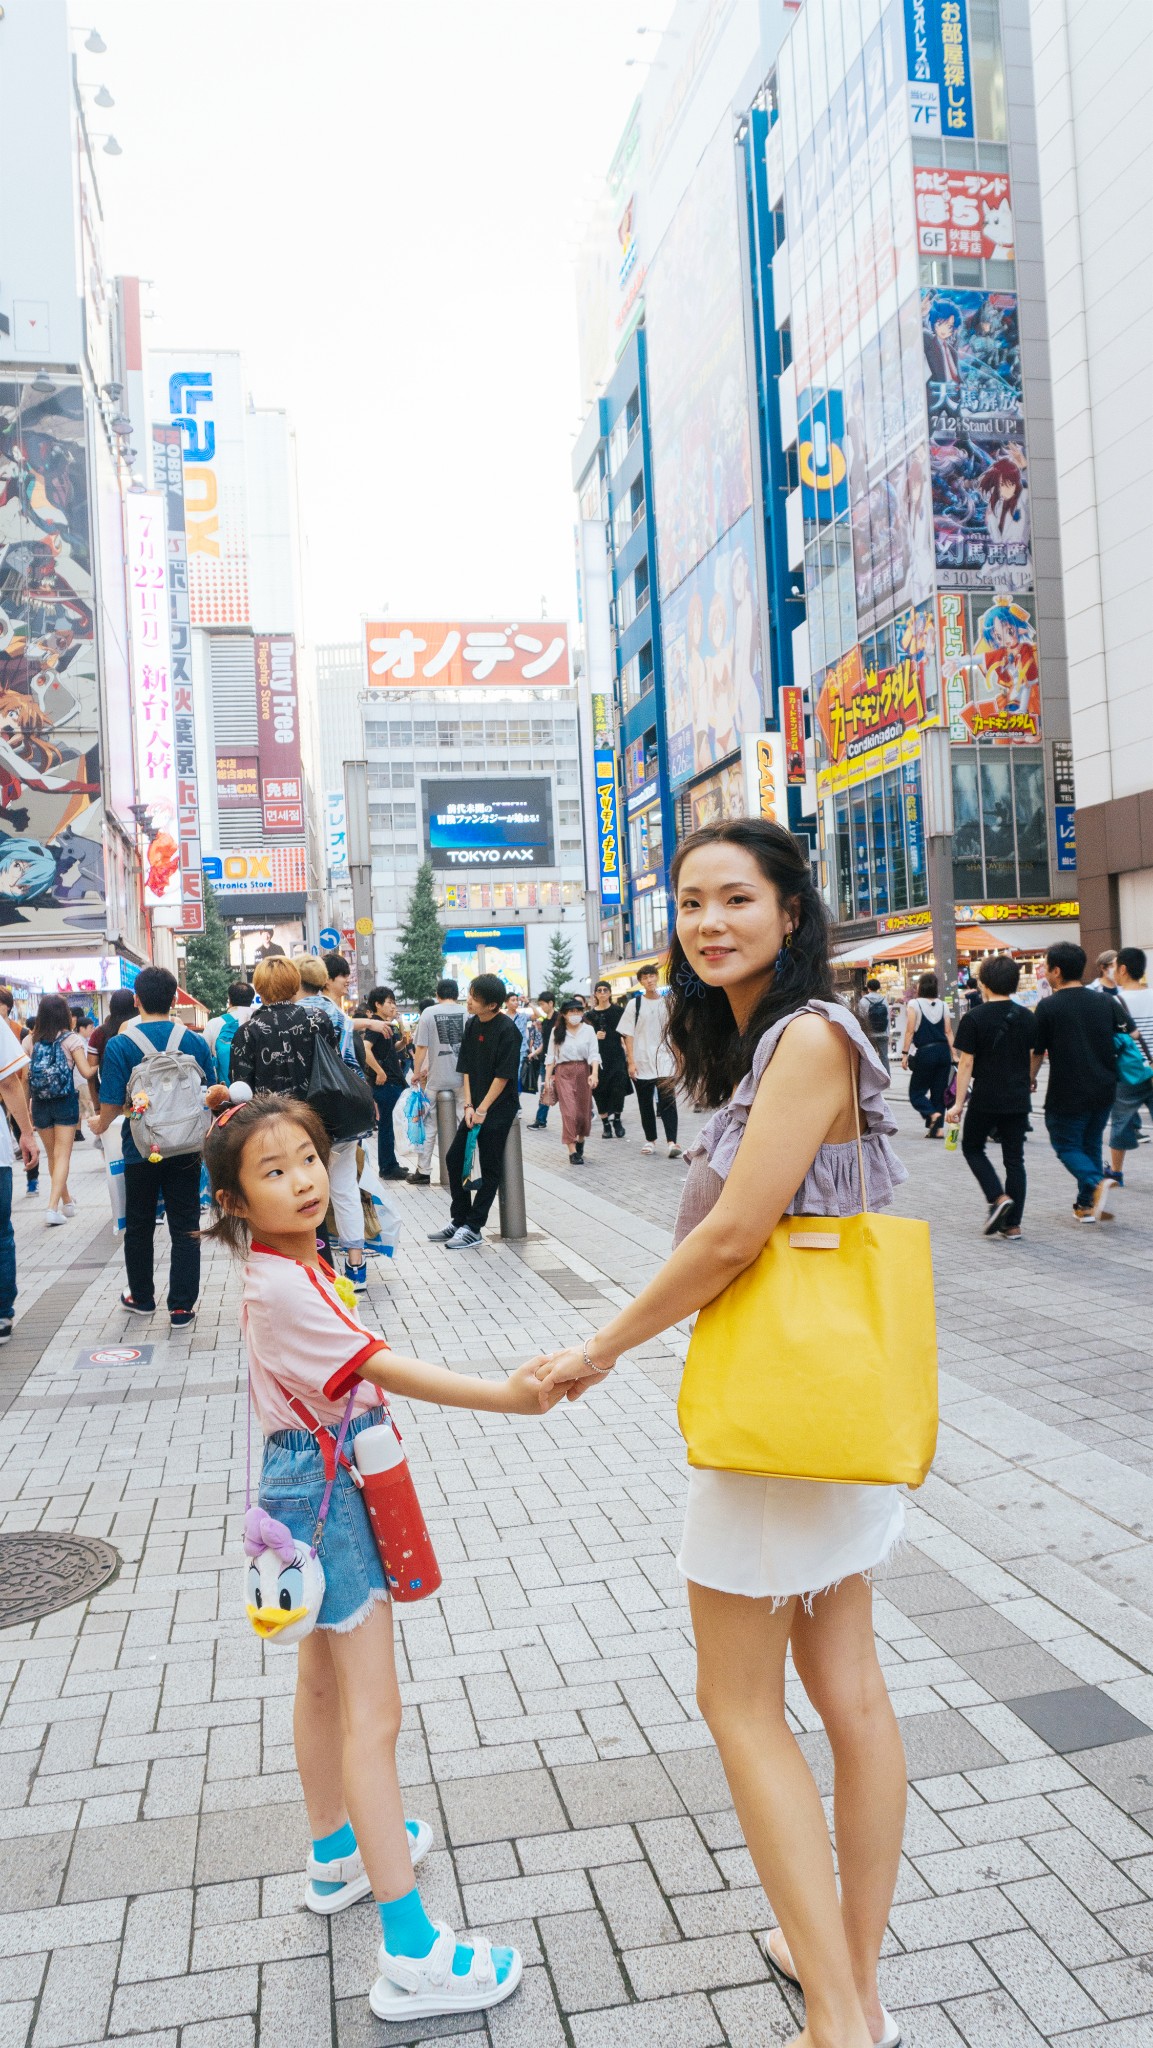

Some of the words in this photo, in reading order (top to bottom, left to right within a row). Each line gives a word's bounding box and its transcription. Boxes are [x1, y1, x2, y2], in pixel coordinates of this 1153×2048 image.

[941, 2, 967, 129] お部屋探しは
[910, 89, 937, 101] 当ビル
[911, 104, 938, 124] 7F
[915, 171, 1008, 198] ホビーランド
[917, 190, 980, 228] ぽち
[922, 231, 944, 248] 6F
[949, 228, 981, 241] 秋葉原
[949, 241, 982, 254] 2号店
[962, 420, 993, 433] Stand
[995, 420, 1018, 434] UP!
[164, 429, 183, 496] HOBBY
[369, 623, 566, 681] オノデン
[257, 642, 271, 687] Flagship
[269, 642, 295, 692] Duty
[260, 690, 271, 720] Store
[830, 656, 926, 762] カードキングダム
[141, 664, 171, 780] 新台入替
[272, 695, 297, 744] Free
[972, 713, 1037, 738] カードキングダム
[266, 782, 298, 798] 免税
[266, 809, 300, 822] 면세점
[446, 803, 493, 815] 前代未聞の
[446, 849, 500, 863] TOKYO
[502, 848, 534, 861] MX
[212, 881, 248, 890] ectronics
[250, 880, 273, 889] Store
[996, 901, 1080, 919] カードキングダム
